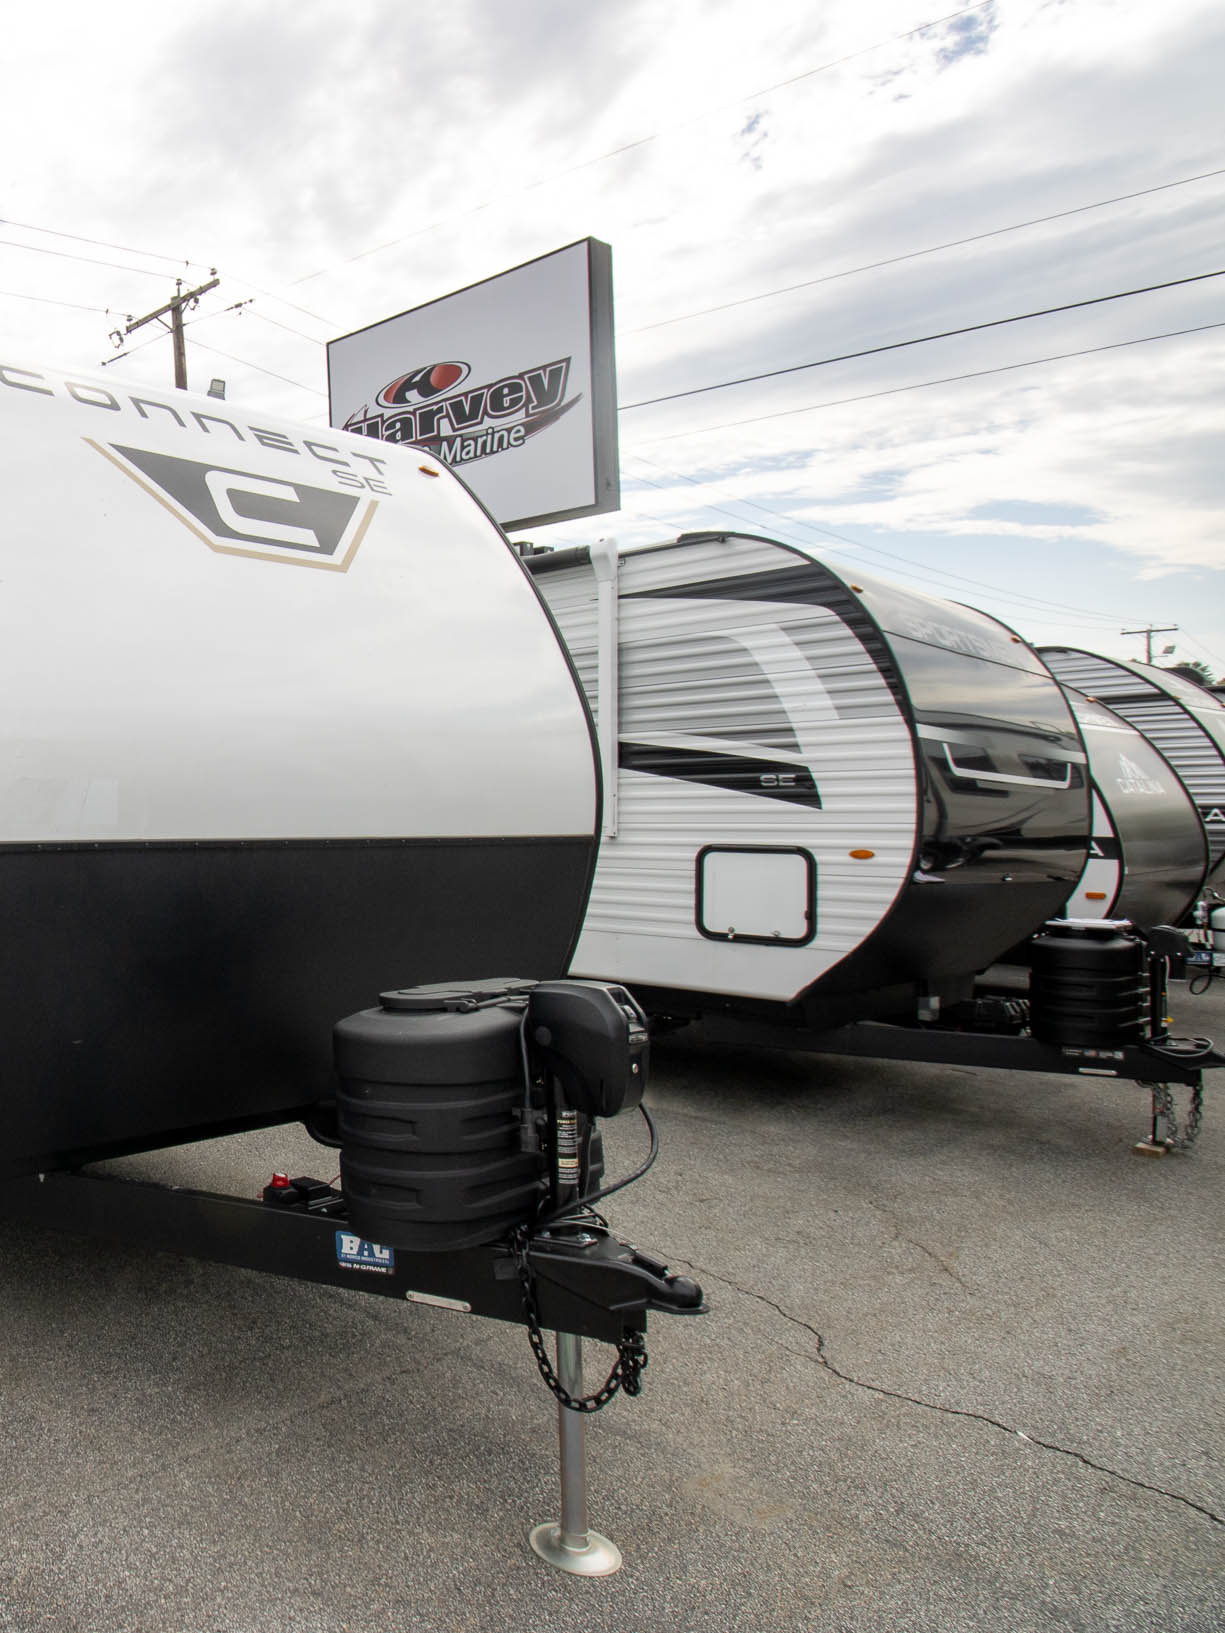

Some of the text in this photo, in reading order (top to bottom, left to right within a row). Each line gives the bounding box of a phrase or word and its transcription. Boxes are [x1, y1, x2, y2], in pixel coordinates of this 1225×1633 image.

[439, 424, 526, 465] Marine
[332, 469, 392, 496] SE
[760, 774, 796, 786] SE
[341, 1235, 390, 1259] BAL
